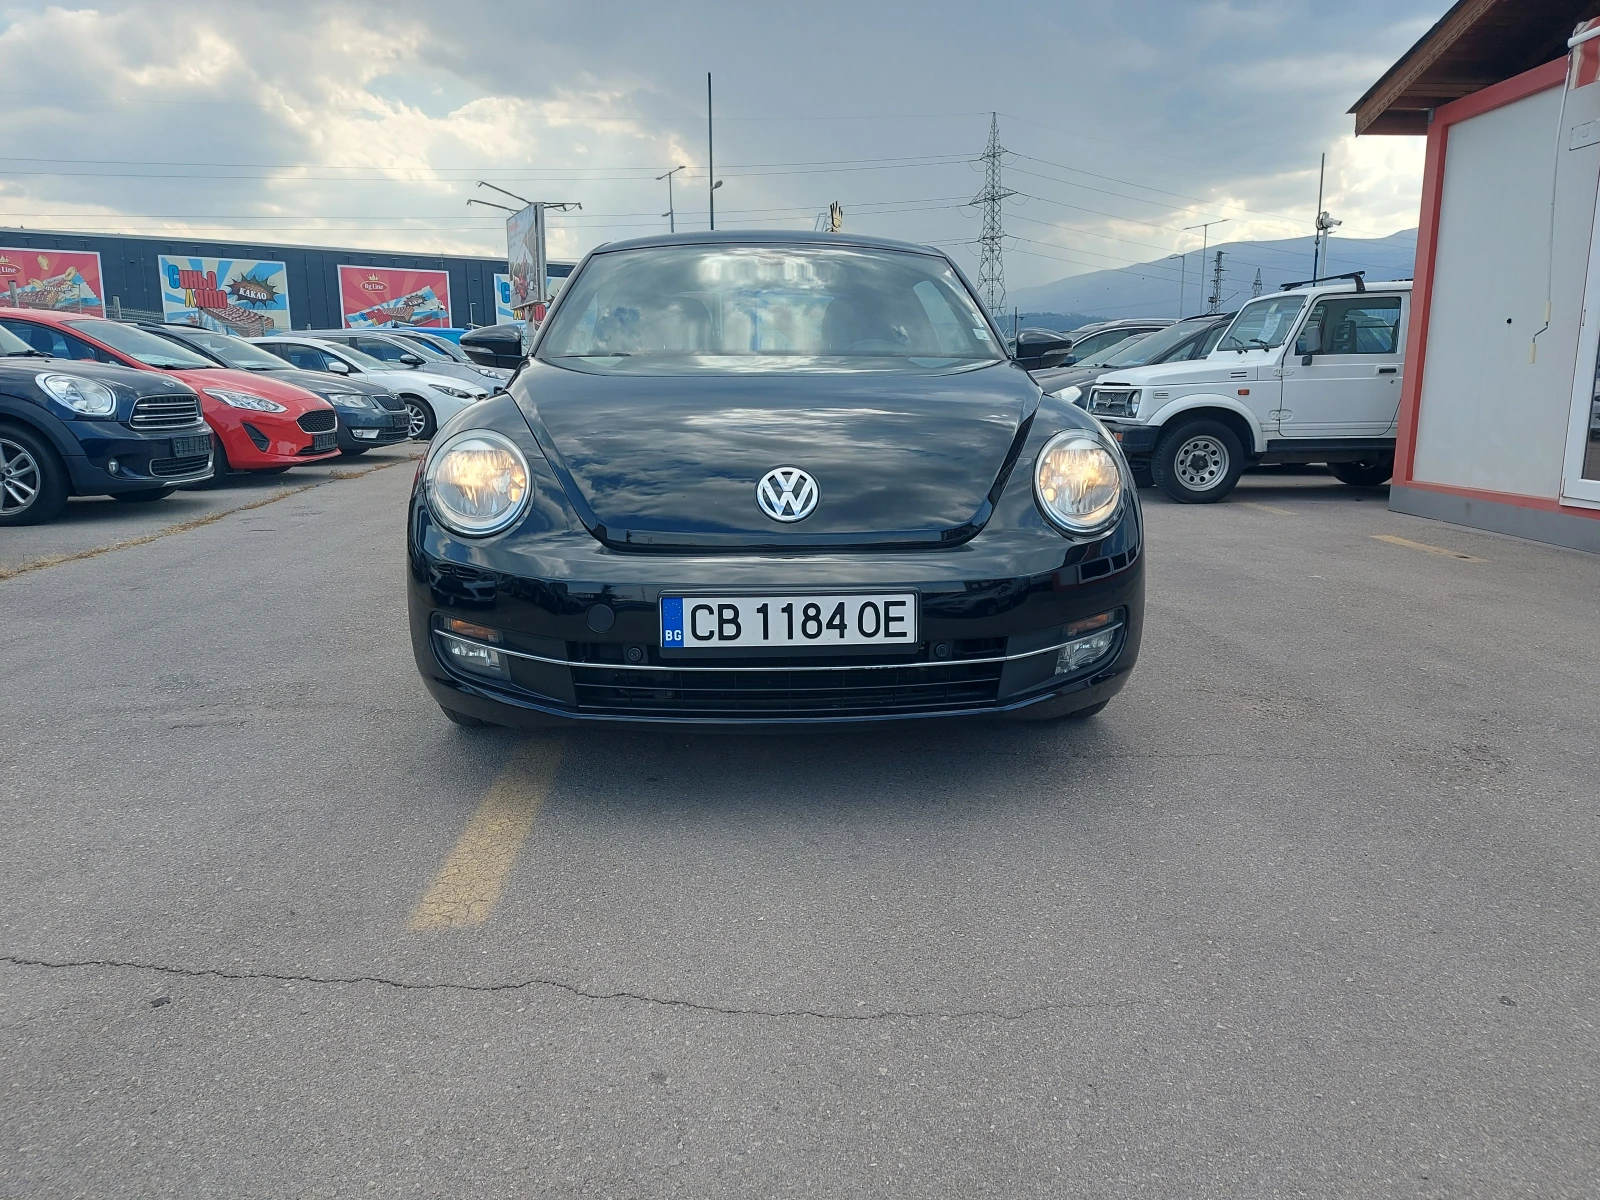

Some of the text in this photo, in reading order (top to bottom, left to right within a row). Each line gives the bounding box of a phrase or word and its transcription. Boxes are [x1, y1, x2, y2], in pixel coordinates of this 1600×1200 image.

[690, 600, 907, 641] CB 1184 OE
[665, 629, 682, 641] BG
